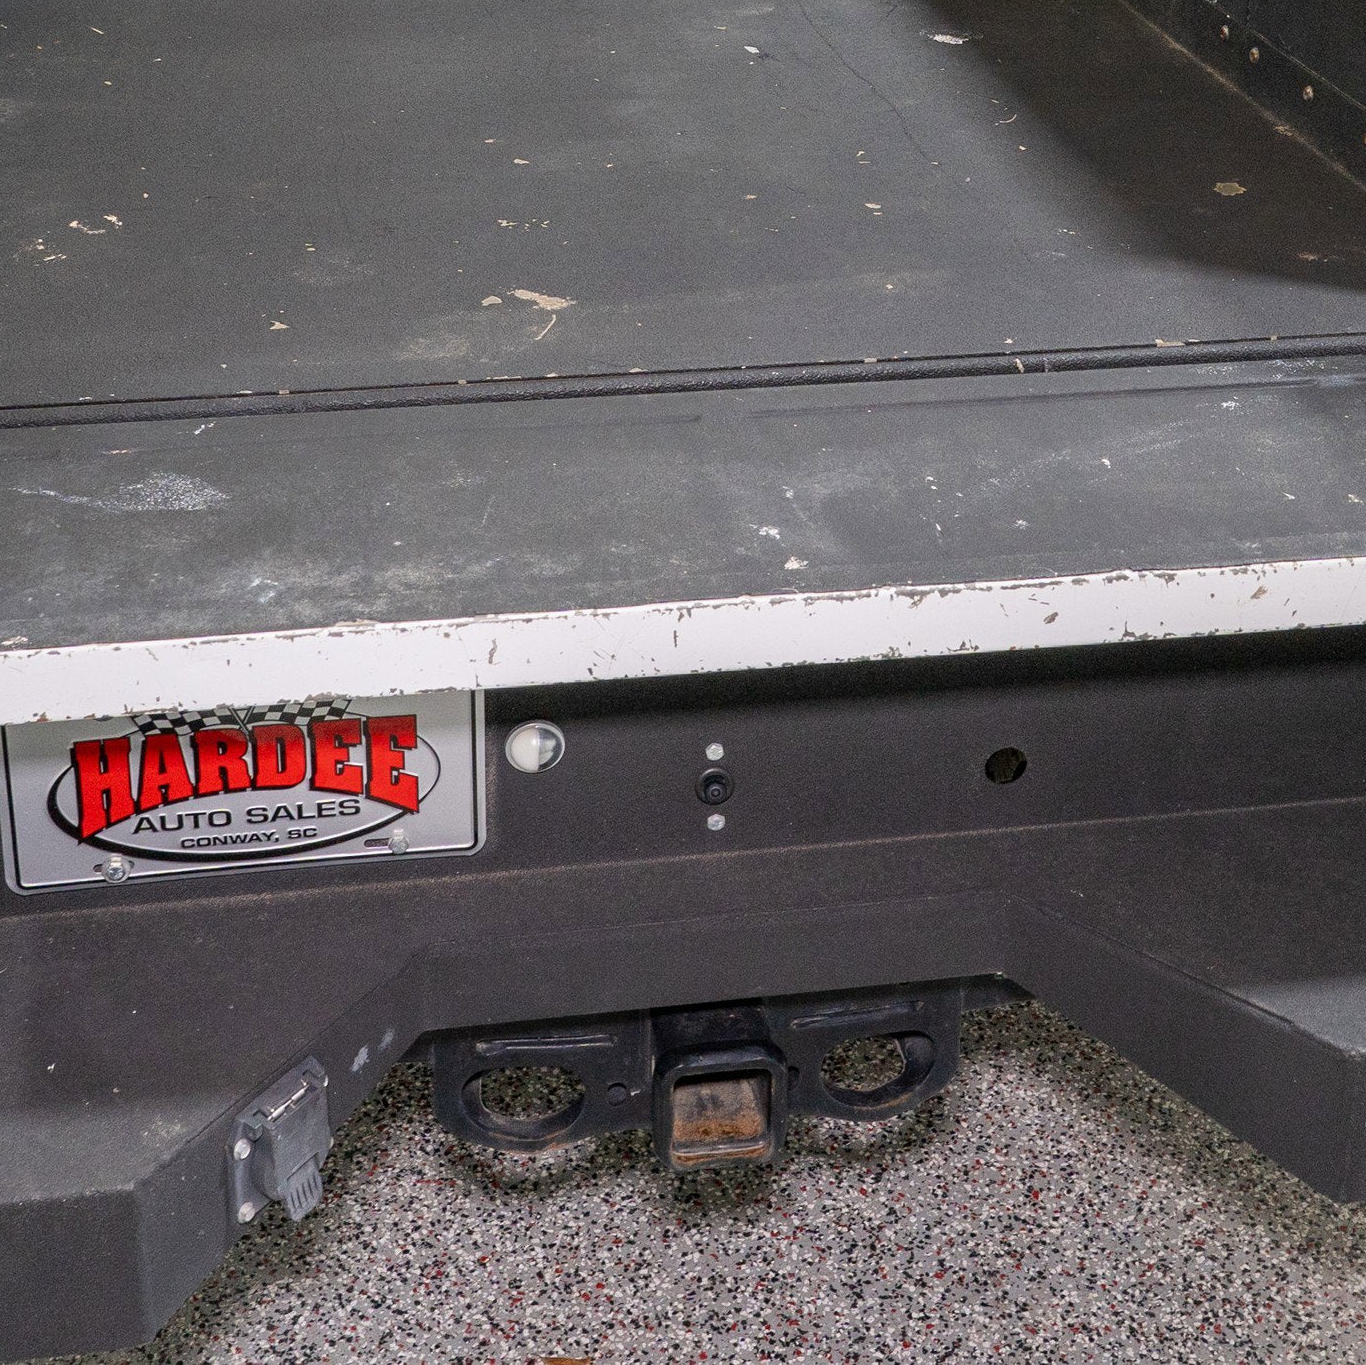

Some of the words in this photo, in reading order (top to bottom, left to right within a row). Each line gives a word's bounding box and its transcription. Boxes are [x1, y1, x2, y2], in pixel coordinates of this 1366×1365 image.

[71, 714, 420, 843] HARDEE
[133, 809, 233, 834] AUTO
[246, 798, 361, 824] SALES
[181, 830, 280, 849] CONWAY,
[287, 827, 318, 840] SC
